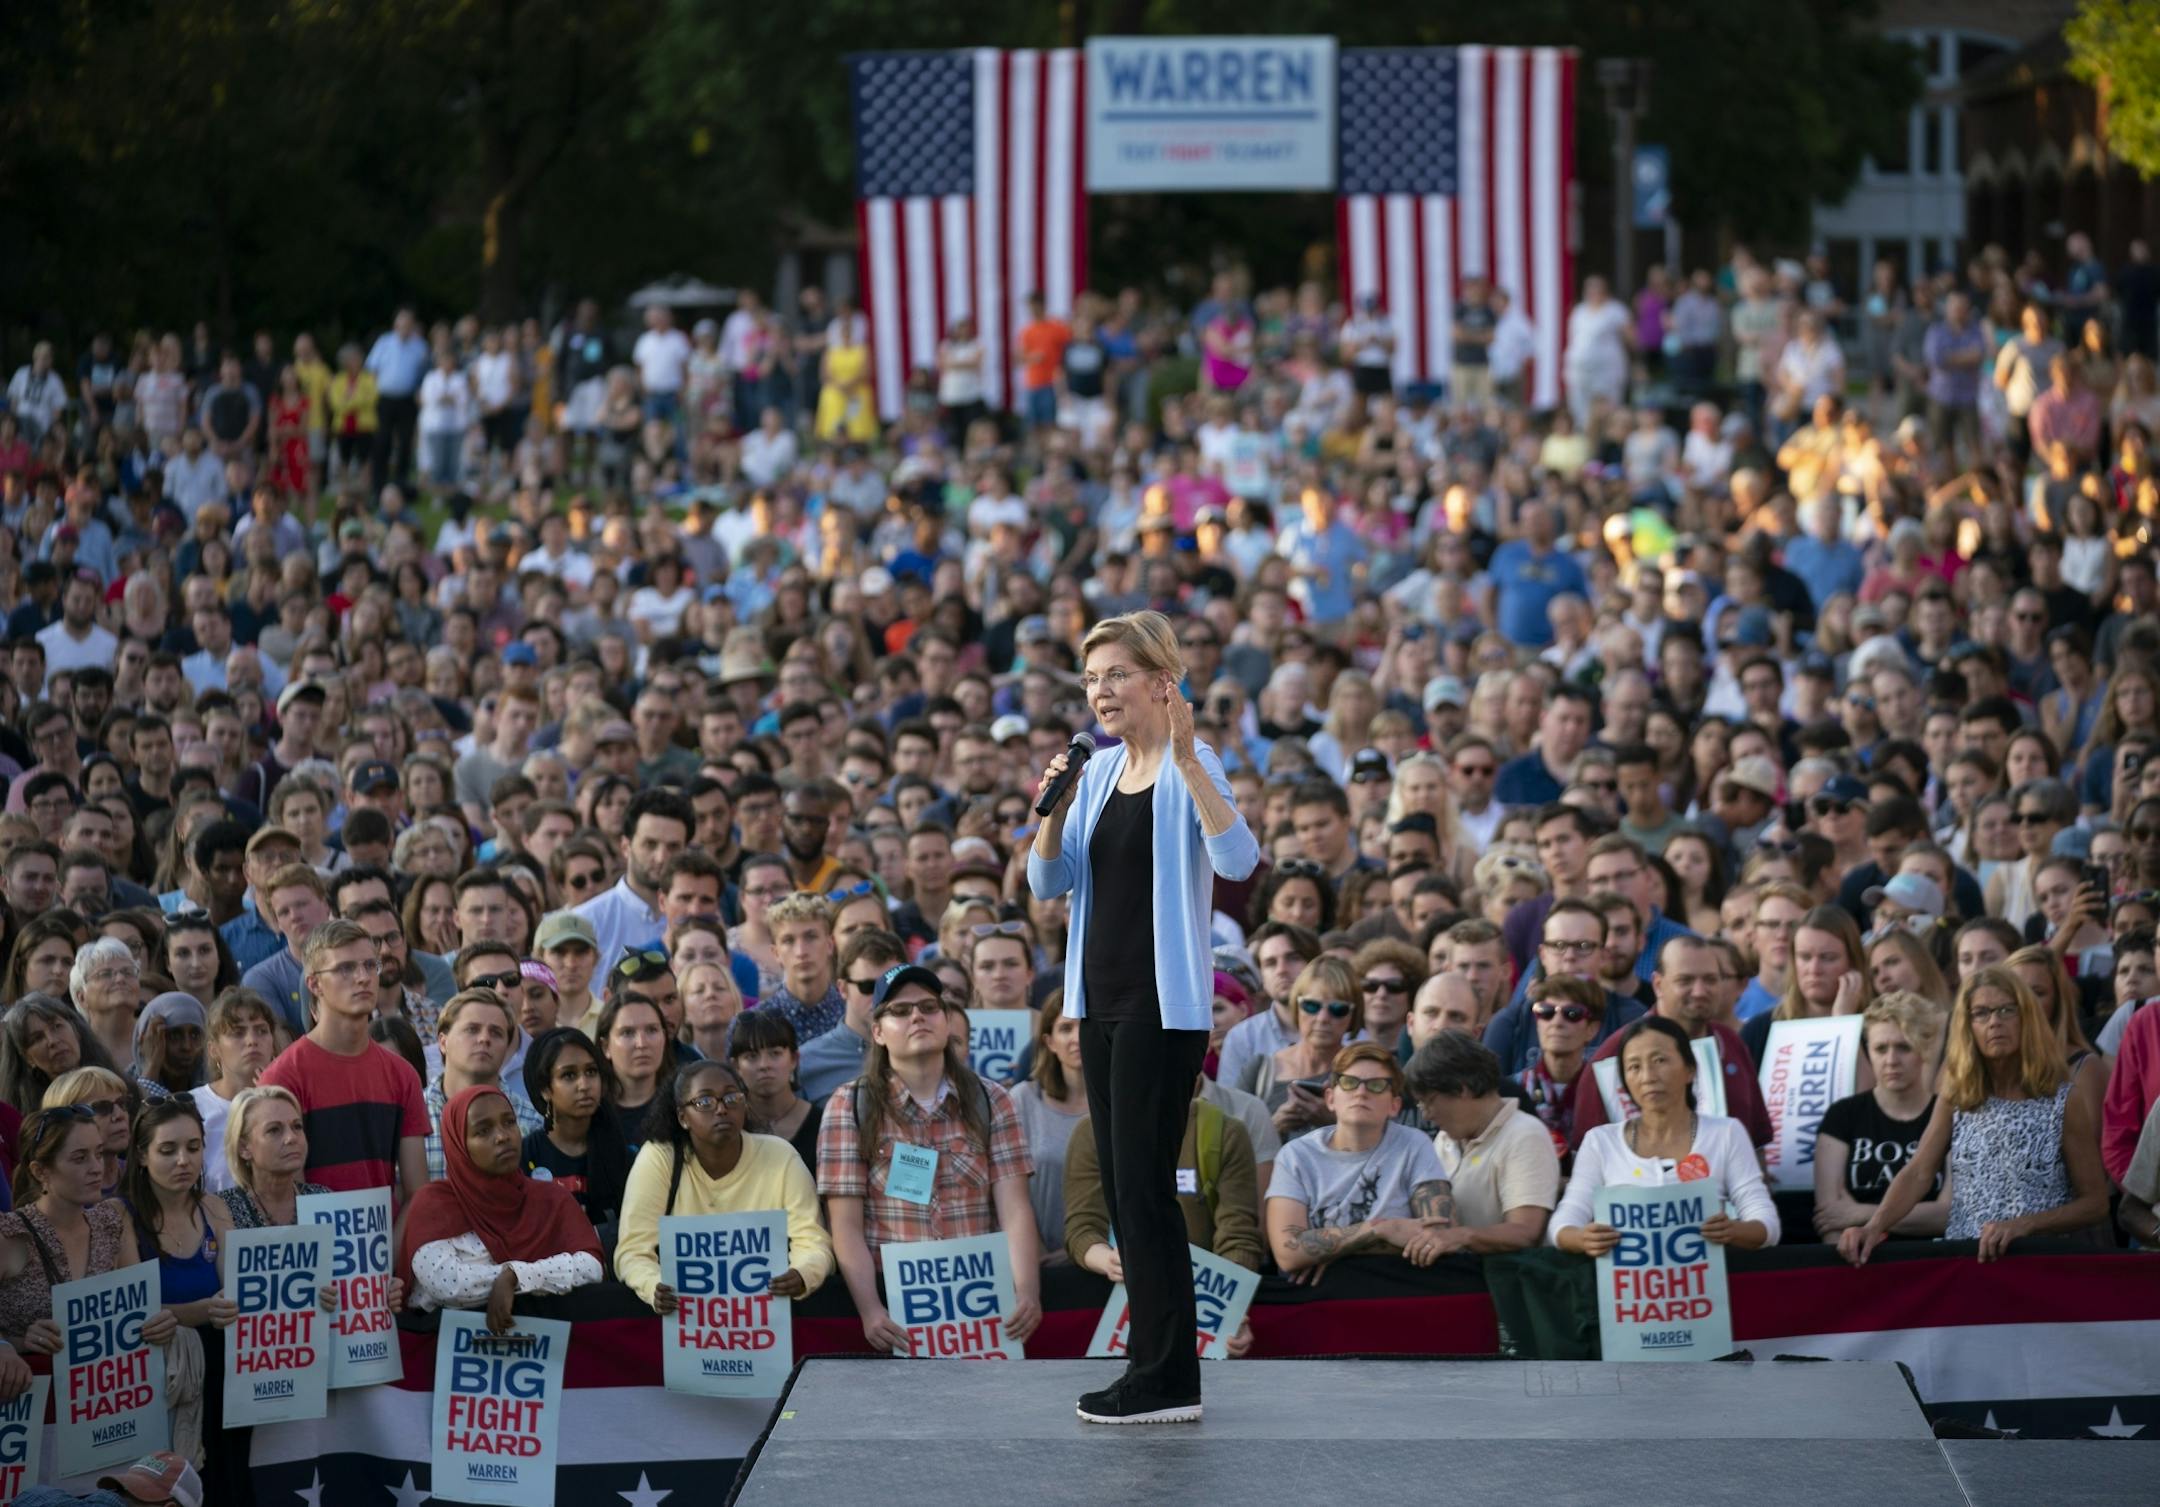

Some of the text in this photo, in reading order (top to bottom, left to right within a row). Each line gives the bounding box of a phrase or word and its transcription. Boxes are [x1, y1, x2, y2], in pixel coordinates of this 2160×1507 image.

[1102, 49, 1313, 102] WARREN
[1765, 1044, 1794, 1166] MINNESOTA
[1796, 1040, 1831, 1166] WARREN
[1852, 1138, 1919, 1164] BOS
[1609, 1197, 1703, 1229] DREAM
[238, 1241, 318, 1274] DREAM
[332, 1233, 389, 1277] BIG
[675, 1226, 770, 1258] DREAM
[1612, 1226, 1707, 1267] BIG
[676, 1256, 772, 1295] BIG
[898, 1251, 995, 1286] DREAM
[1613, 1263, 1709, 1300] FIGHT
[67, 1280, 147, 1326] DREAM
[238, 1271, 315, 1313] BIG
[902, 1281, 1000, 1324] BIG
[1615, 1298, 1713, 1323] HARD
[677, 1294, 774, 1329] FIGHT
[68, 1311, 149, 1365] BIG
[237, 1311, 316, 1350] FIGHT
[679, 1328, 776, 1351] HARD
[906, 1317, 1002, 1358] FIGHT
[1640, 1330, 1693, 1345] WARREN
[236, 1346, 315, 1374] HARD
[348, 1341, 388, 1359] WARREN
[702, 1358, 753, 1373] WARREN
[69, 1349, 150, 1400] FIGHT
[253, 1379, 293, 1397] WARREN
[451, 1355, 546, 1399] BIG
[71, 1385, 153, 1424] HARD
[448, 1395, 544, 1433] FIGHT
[92, 1420, 136, 1443] WARREN
[447, 1429, 542, 1457] HARD
[467, 1462, 517, 1479] WARREN
